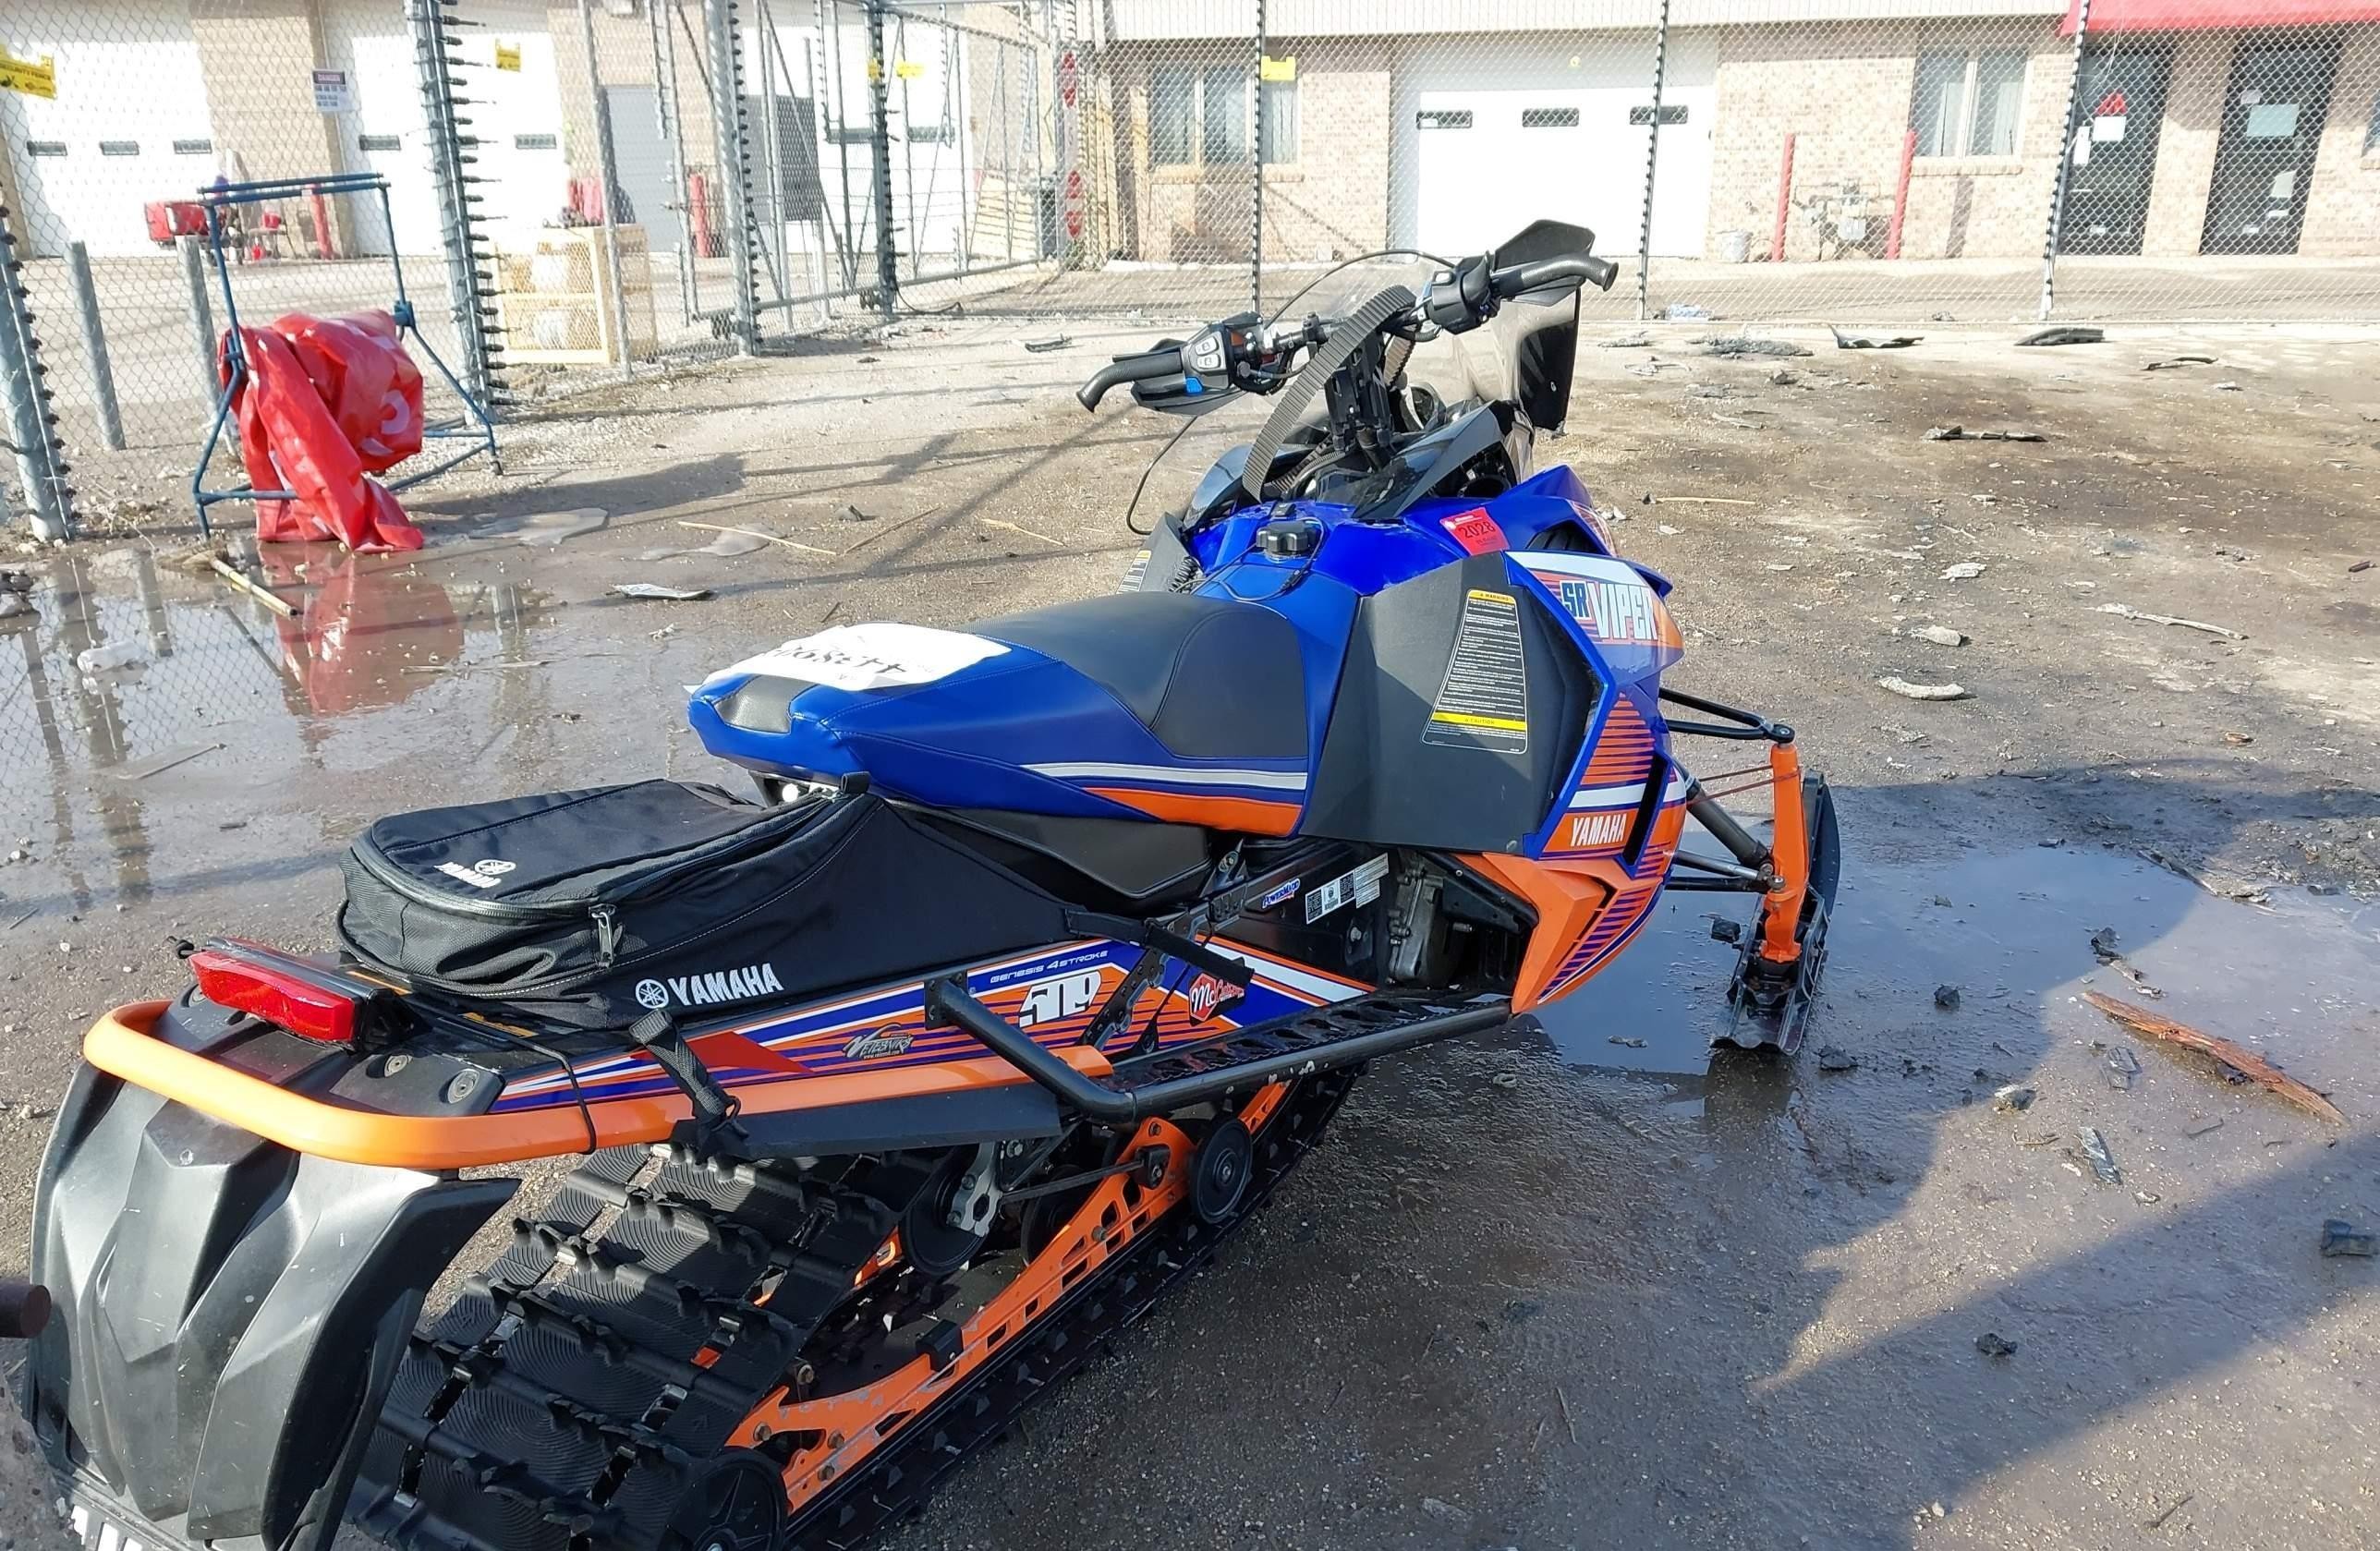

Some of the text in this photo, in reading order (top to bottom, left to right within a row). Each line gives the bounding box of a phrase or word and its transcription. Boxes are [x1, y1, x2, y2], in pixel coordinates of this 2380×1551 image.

[1459, 521, 1496, 539] 2028
[1485, 593, 1509, 601] WARNING
[1561, 582, 1658, 640] SR VIPER
[1571, 813, 1627, 847] YAMAHA
[667, 963, 784, 1006] YAMAHA
[990, 964, 1044, 984] GENESIS
[1019, 970, 1101, 1028] 509
